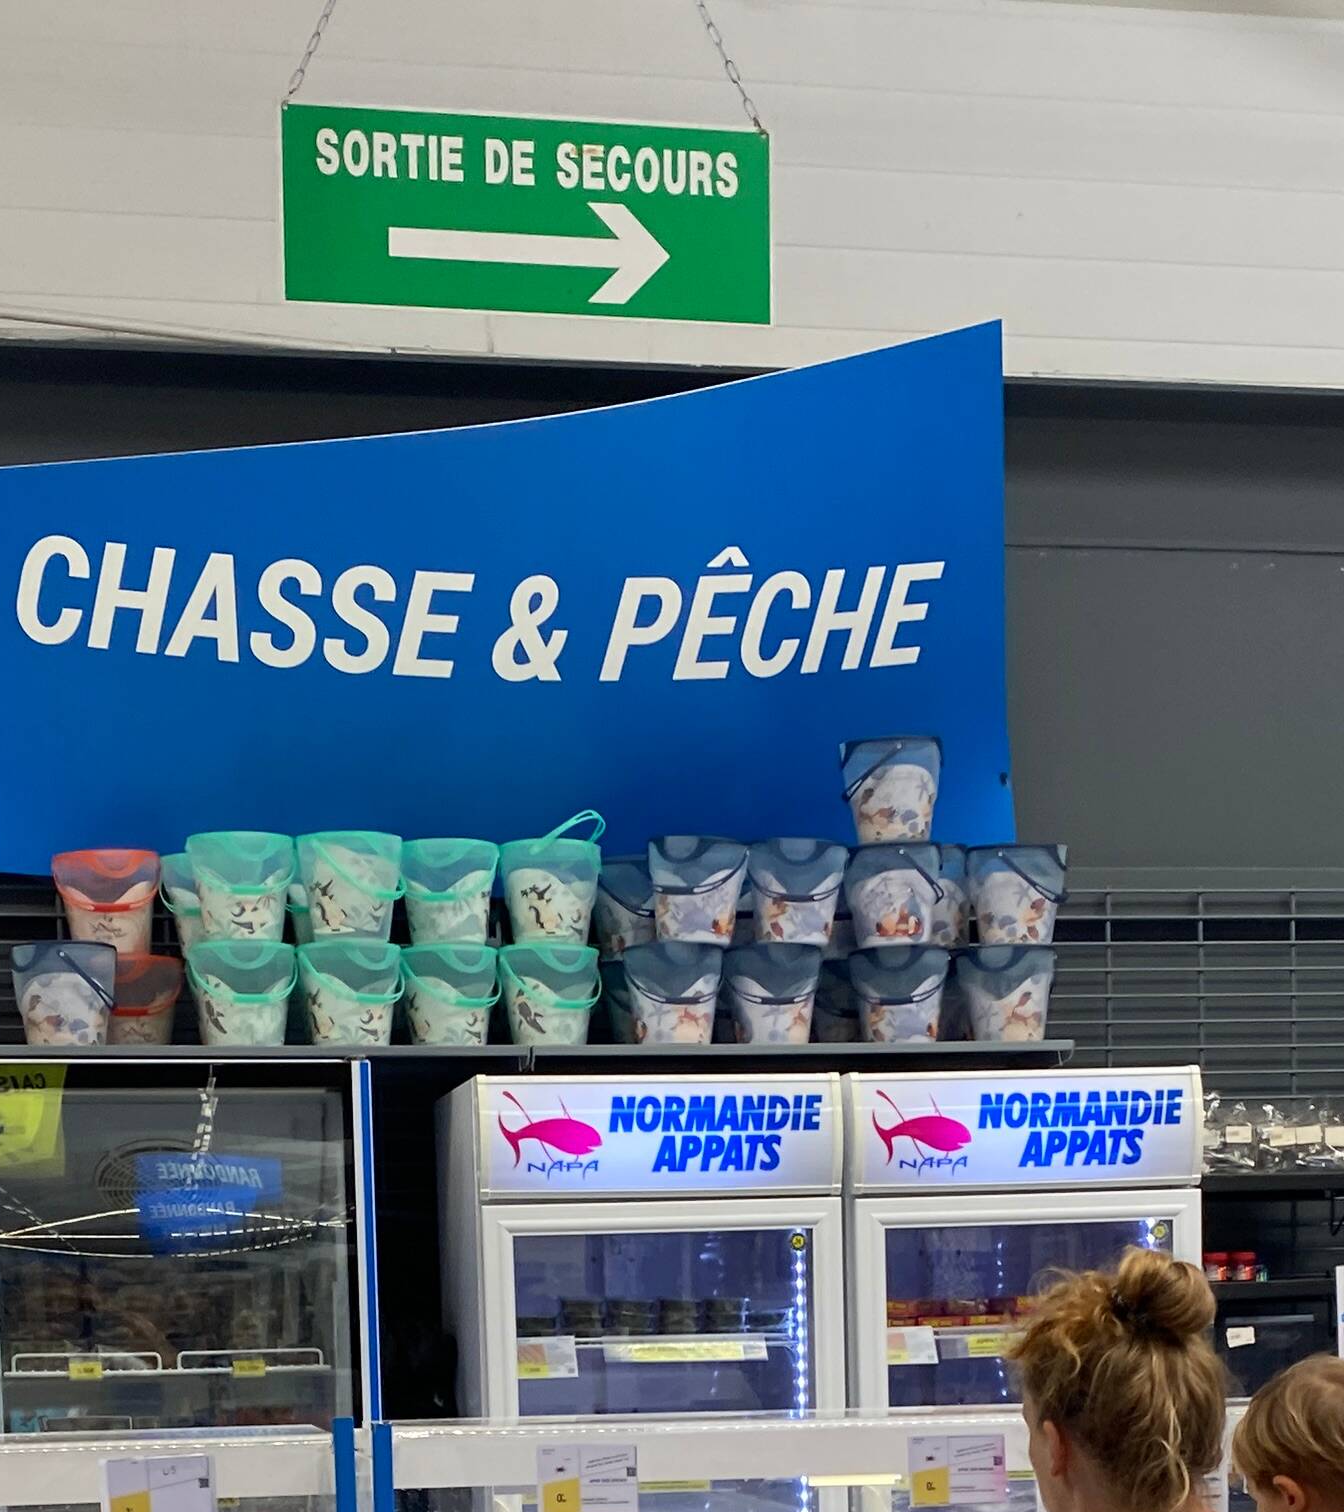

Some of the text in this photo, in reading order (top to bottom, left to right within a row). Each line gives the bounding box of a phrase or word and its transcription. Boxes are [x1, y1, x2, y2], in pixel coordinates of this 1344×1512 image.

[315, 128, 740, 199] SORTIE DE SECOURS
[15, 534, 946, 683] CHASSE & PÊCHE
[608, 1093, 823, 1133] NORMANDIE
[978, 1088, 1184, 1128] NORMANDIE
[651, 1134, 782, 1174] APPATS
[898, 1154, 969, 1177] NAPA
[1018, 1127, 1145, 1169] APPATS
[526, 1158, 600, 1181] NAPA
